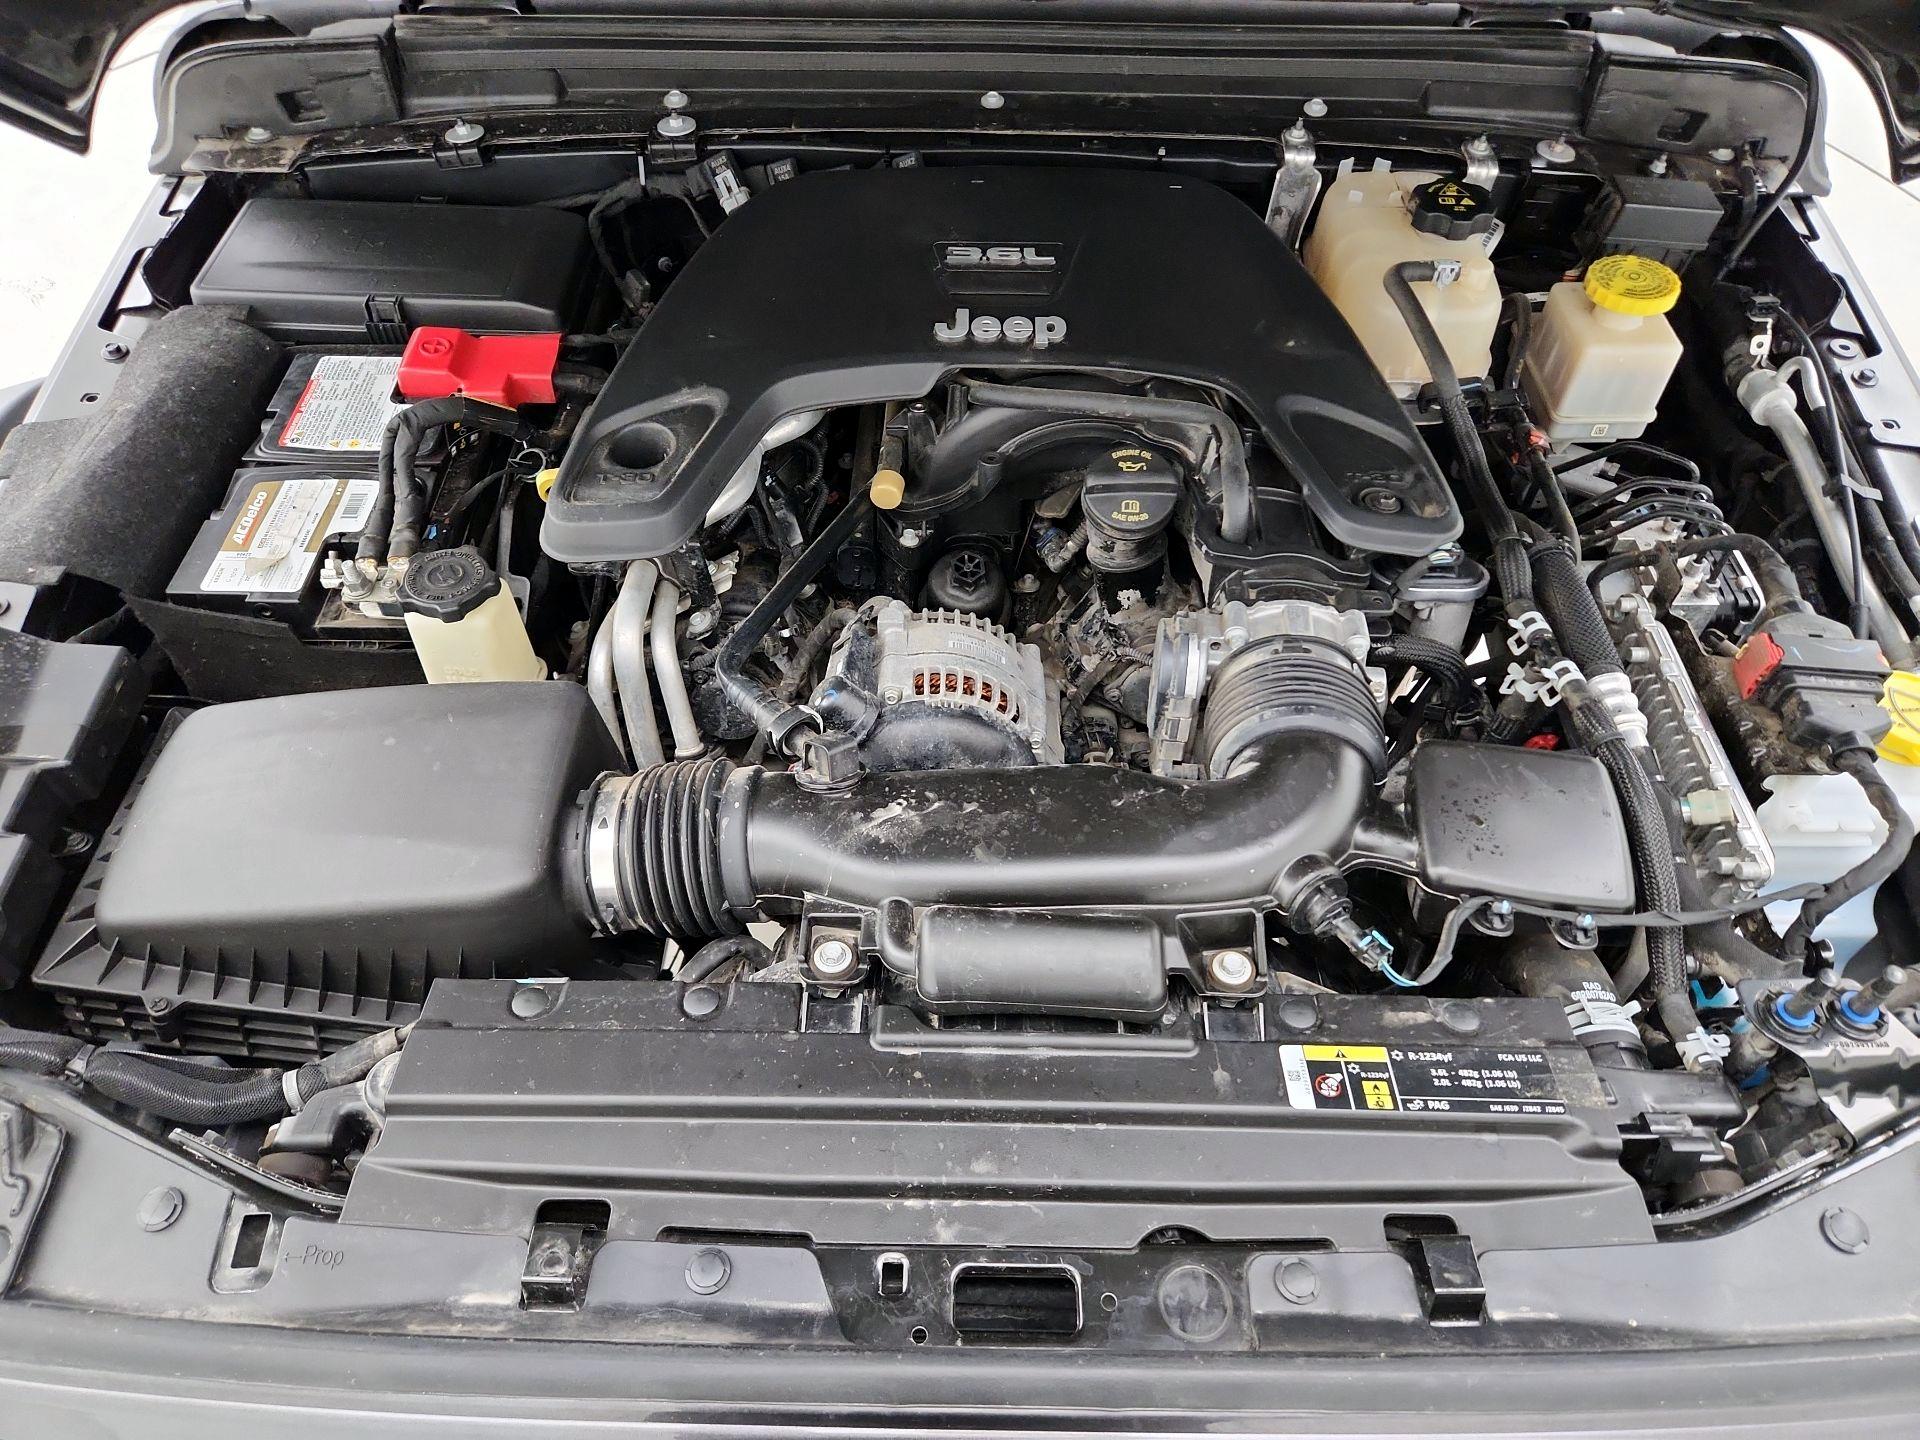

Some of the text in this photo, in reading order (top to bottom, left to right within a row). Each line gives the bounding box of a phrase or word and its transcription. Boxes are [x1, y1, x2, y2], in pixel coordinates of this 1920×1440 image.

[945, 246, 1056, 265] 3.6L
[934, 308, 1067, 349] Jeep
[1112, 450, 1152, 459] ENGINE OIL
[233, 491, 268, 545] ACDelco
[1112, 512, 1126, 520] SAE
[1582, 982, 1602, 990] RAD
[1408, 1052, 1543, 1063] R-1234yf FCA US LLC
[1503, 1070, 1518, 1080] Lb)
[1433, 1078, 1452, 1086] 2.0L
[1507, 1080, 1521, 1090] Lb)
[1428, 1100, 1450, 1110] PAG
[1490, 1104, 1503, 1112] SAE
[302, 1244, 344, 1272] Prop
